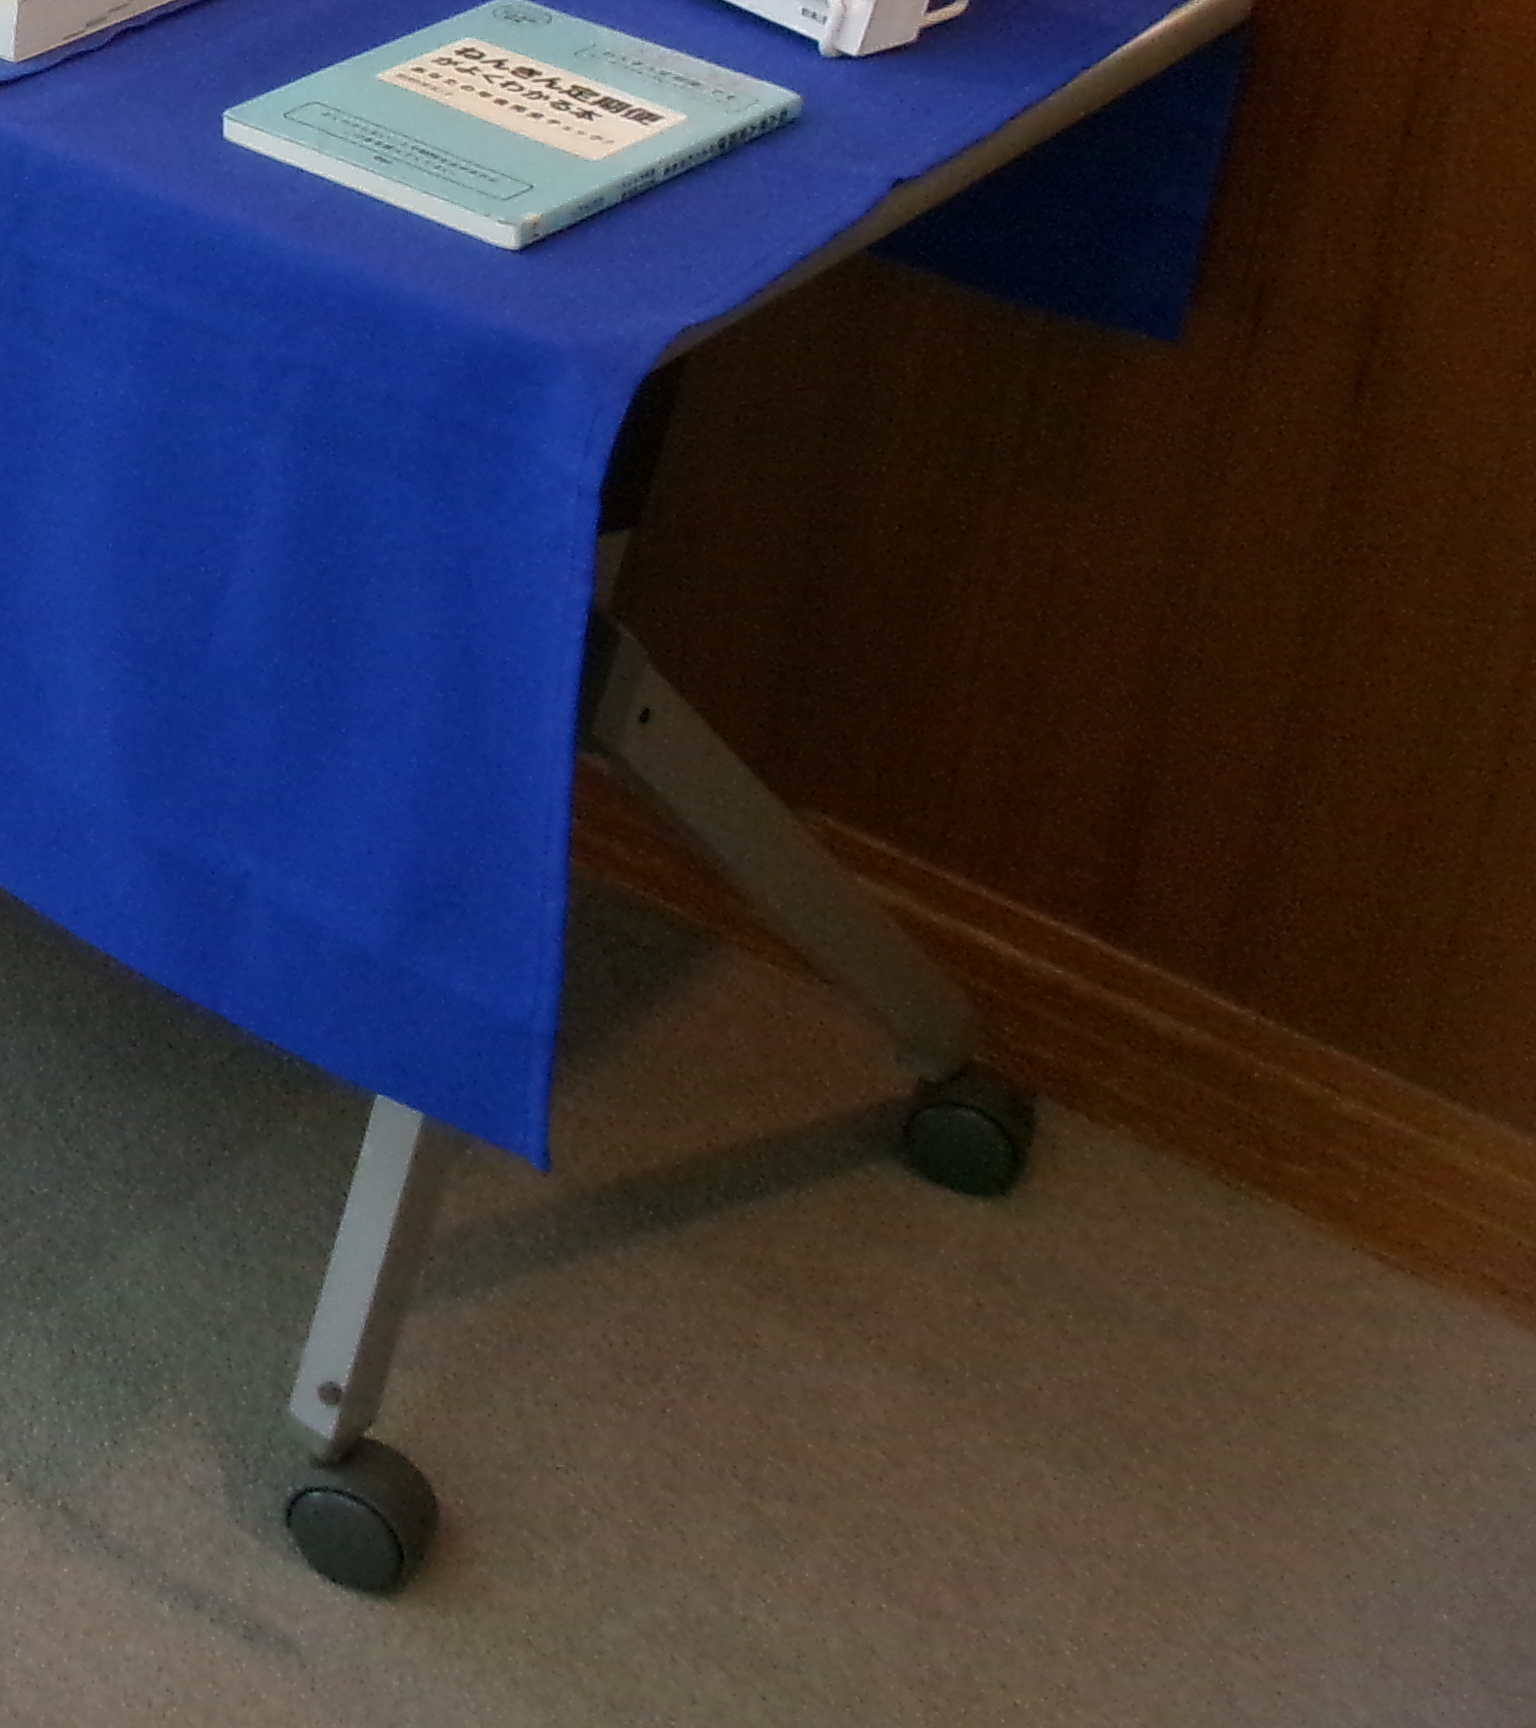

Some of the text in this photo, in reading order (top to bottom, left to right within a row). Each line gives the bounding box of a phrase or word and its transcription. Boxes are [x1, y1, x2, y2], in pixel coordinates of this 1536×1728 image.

[433, 55, 605, 124] がよくわかる本
[453, 46, 666, 127] ねんきん定期便
